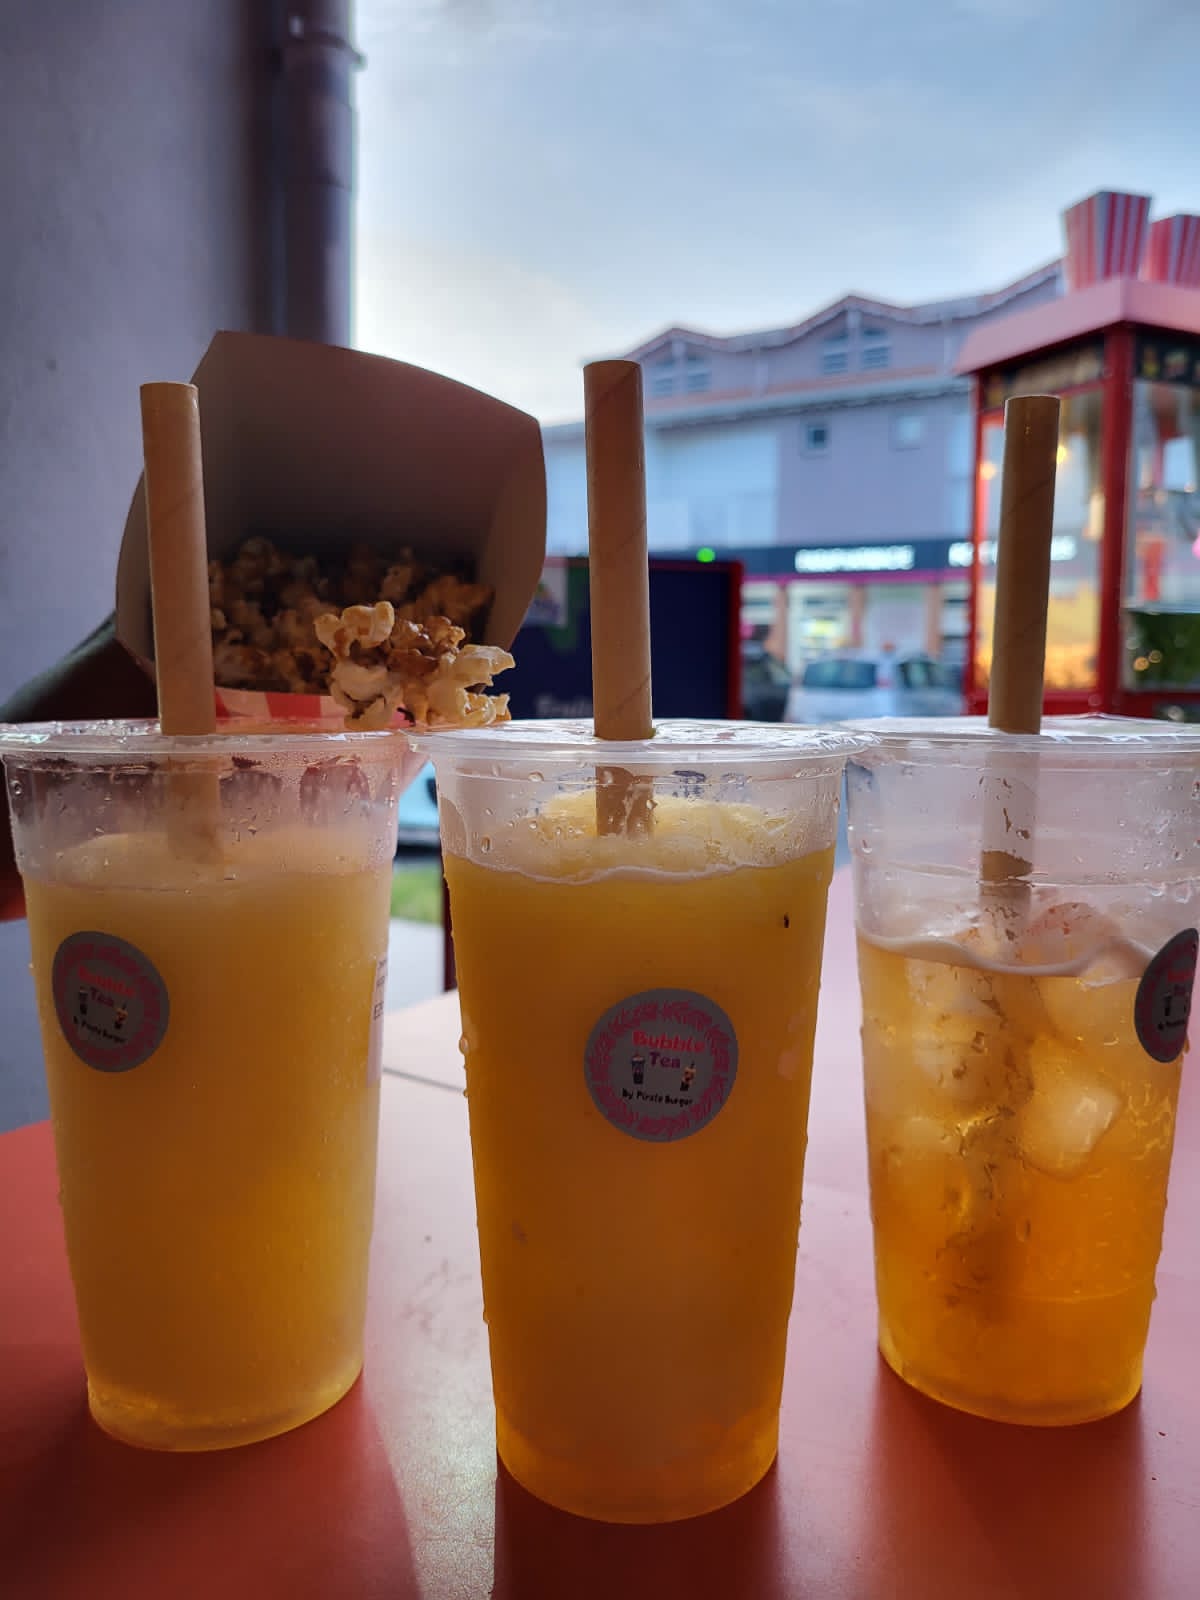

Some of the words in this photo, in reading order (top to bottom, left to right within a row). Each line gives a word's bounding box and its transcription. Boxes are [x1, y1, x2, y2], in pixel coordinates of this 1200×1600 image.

[632, 1030, 706, 1054] Bubble
[649, 1051, 682, 1069] Tea
[637, 1090, 665, 1104] Pirate
[665, 1095, 695, 1108] Burger
